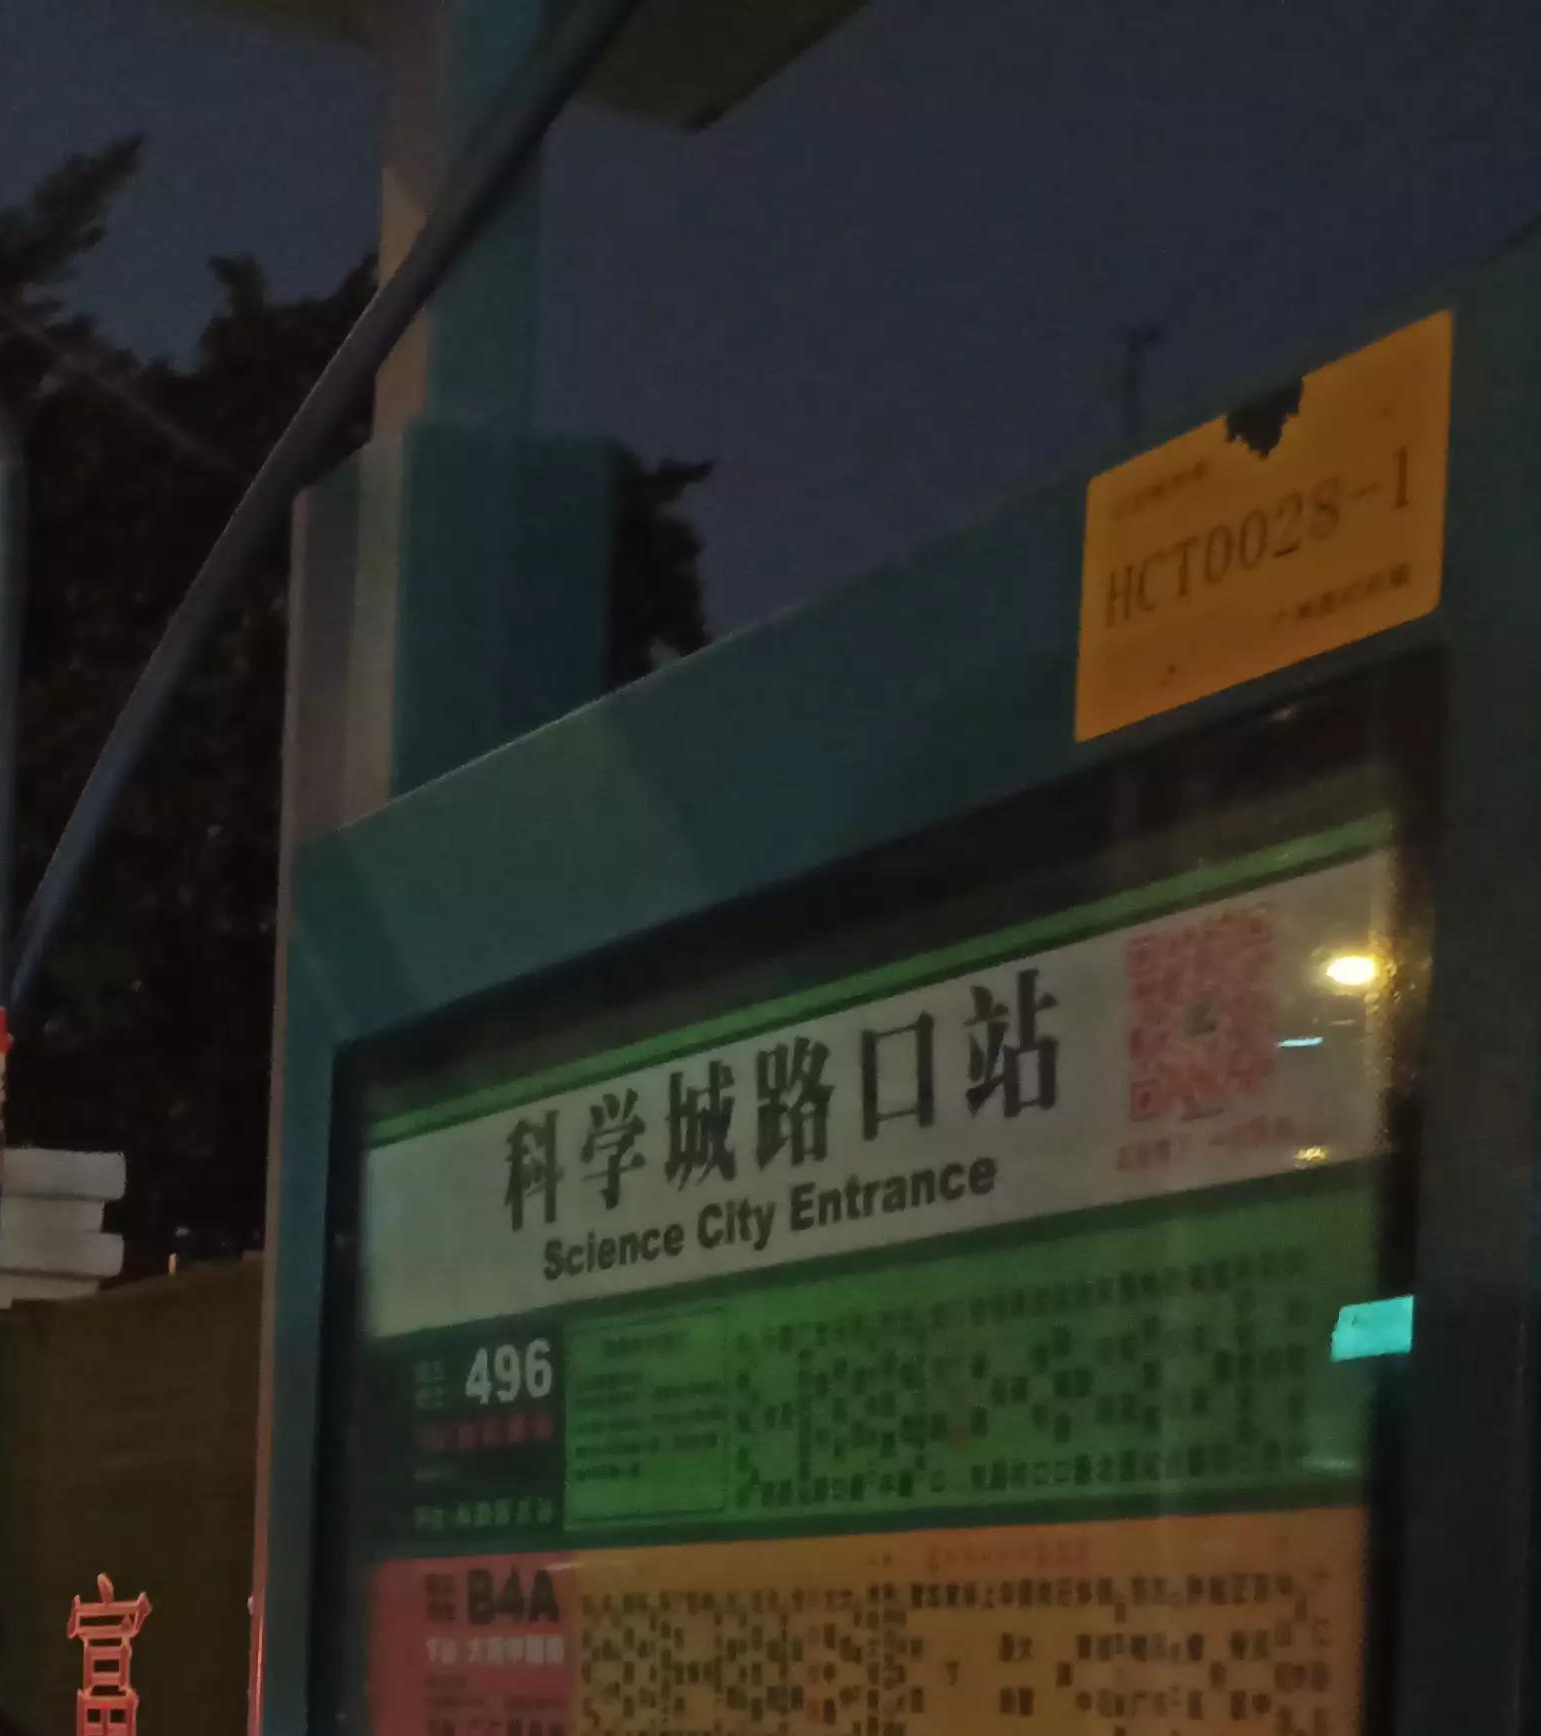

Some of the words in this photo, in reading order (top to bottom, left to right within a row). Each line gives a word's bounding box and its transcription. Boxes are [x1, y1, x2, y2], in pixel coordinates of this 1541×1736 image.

[505, 968, 1058, 1230] 科学城路口站
[542, 1223, 684, 1281] Science
[697, 1198, 775, 1252] City
[789, 1157, 997, 1231] Entrance
[464, 1337, 553, 1405] 496
